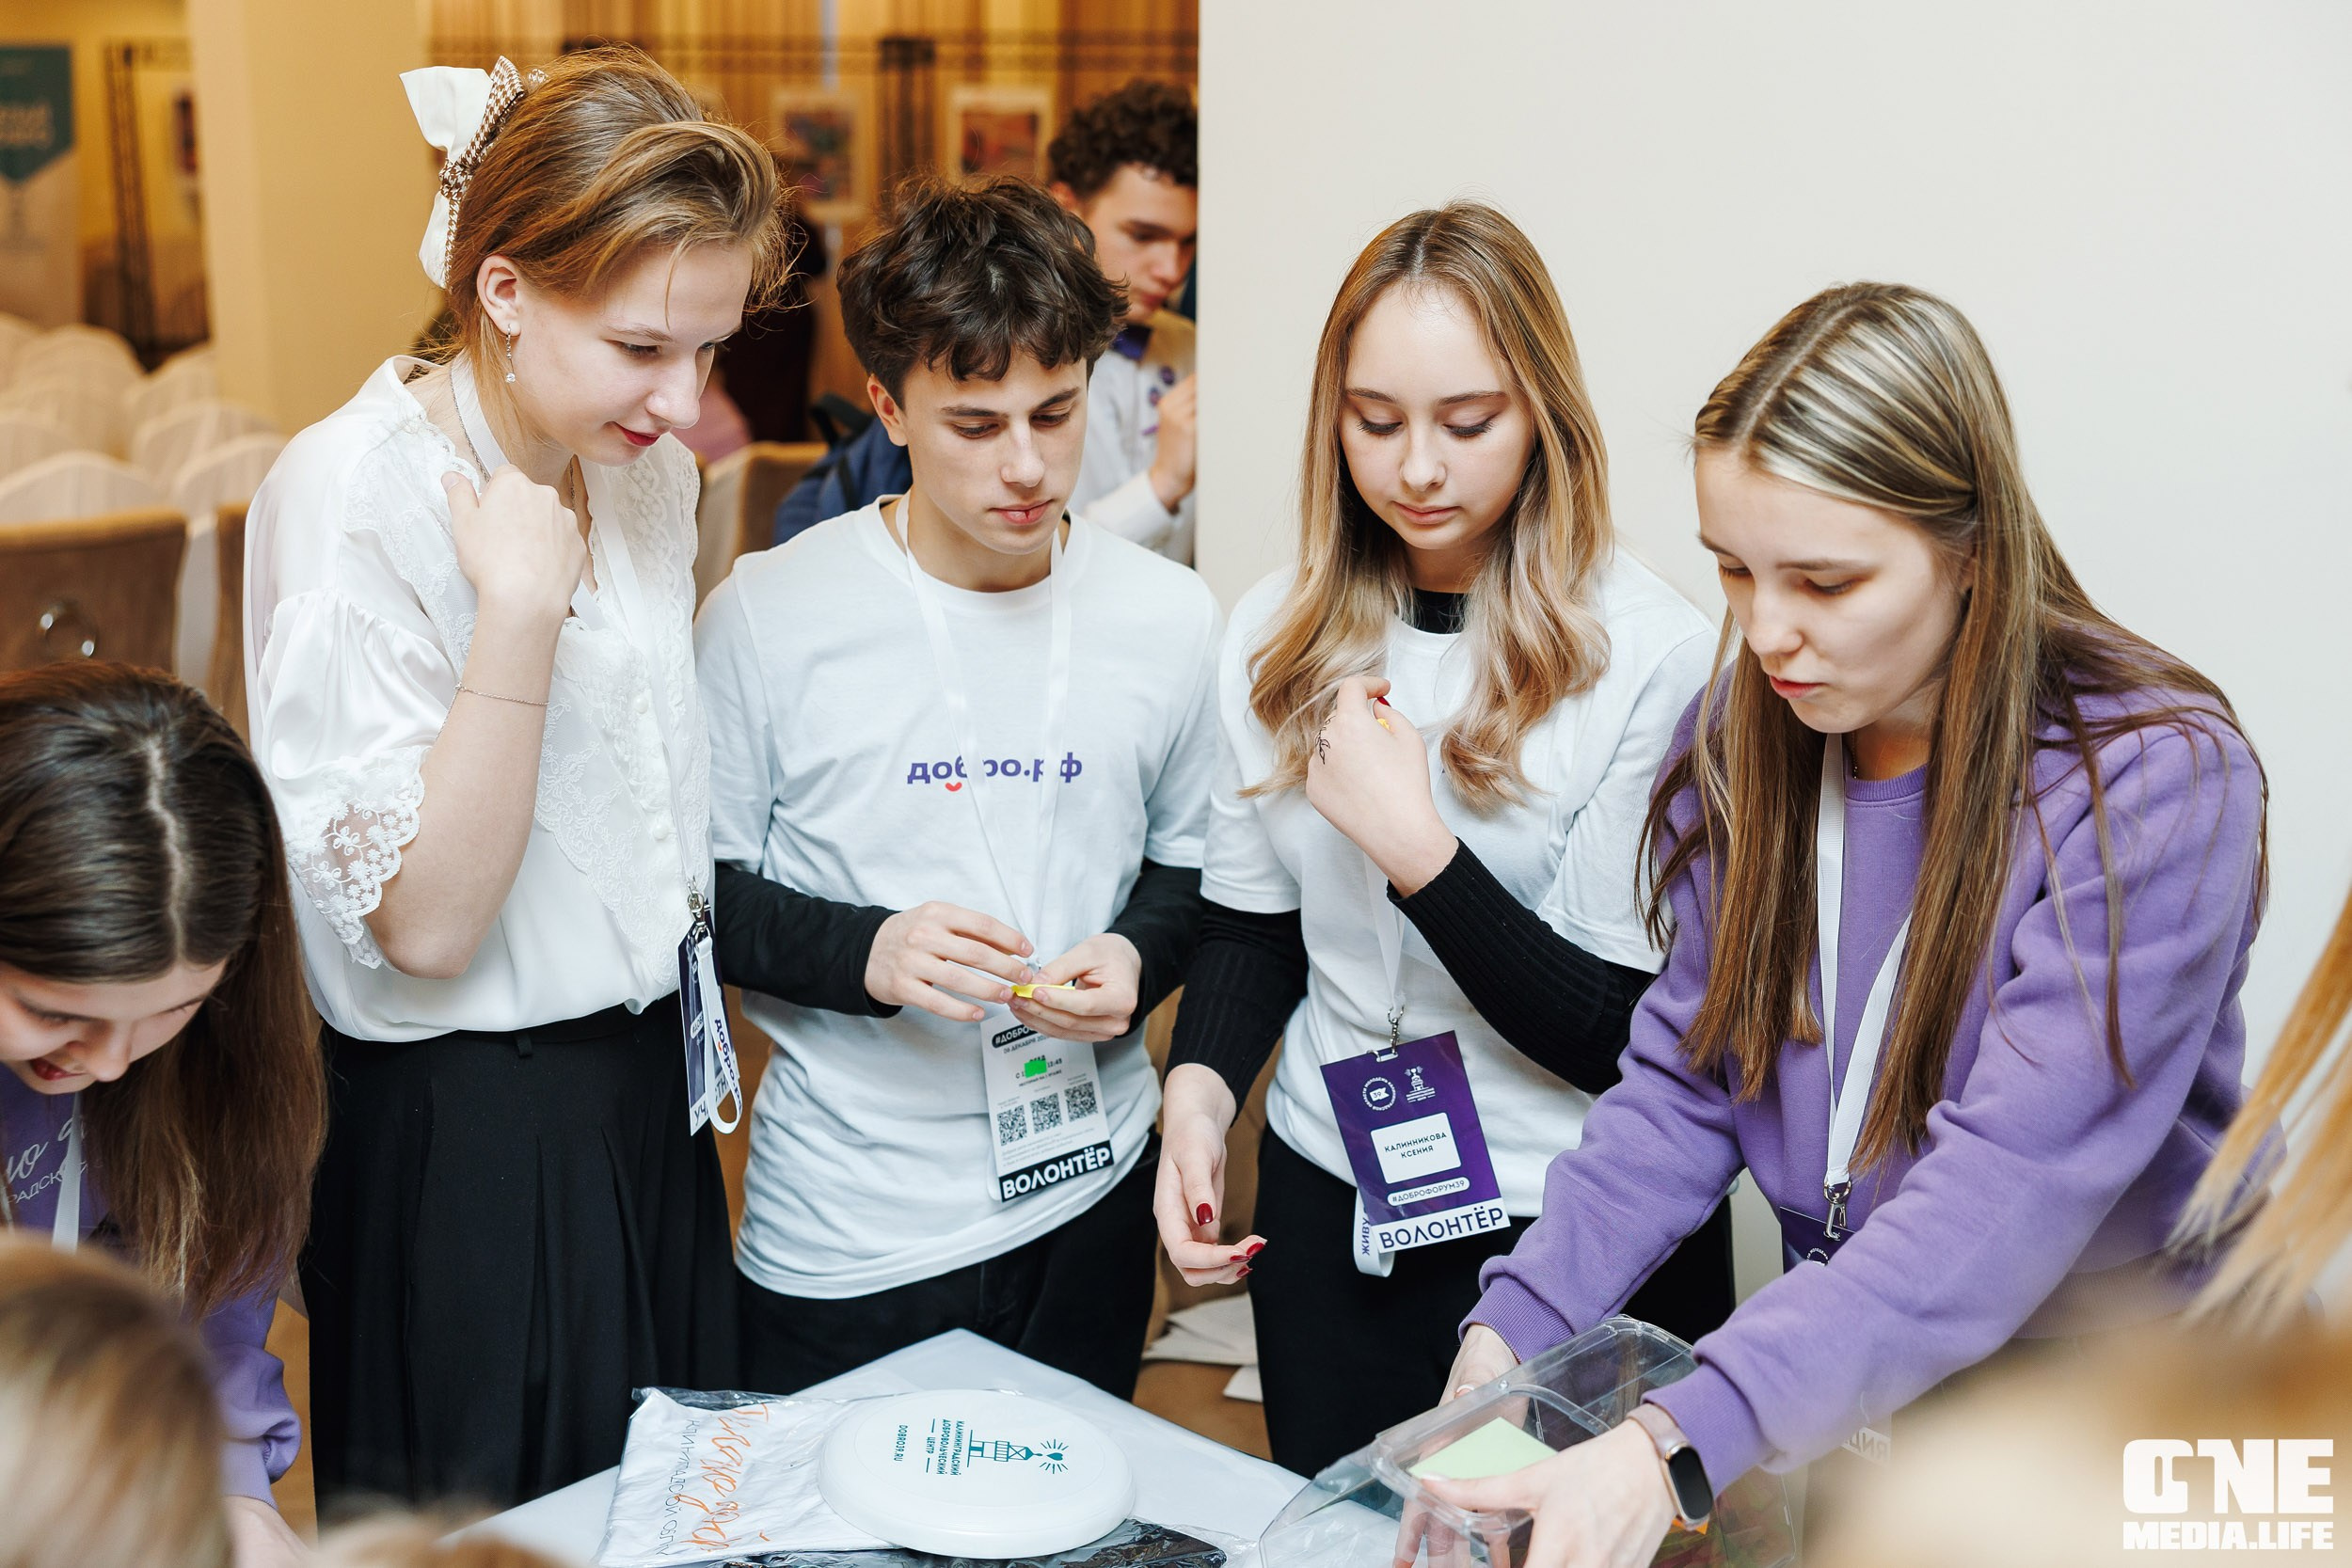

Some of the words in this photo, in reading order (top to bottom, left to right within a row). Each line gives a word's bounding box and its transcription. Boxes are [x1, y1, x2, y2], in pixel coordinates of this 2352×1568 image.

[995, 1026, 1032, 1044] #ДОБРО
[1384, 1132, 1447, 1152] КАЛИННИКОВА
[1400, 1145, 1434, 1159] КСЕНИЯ
[1001, 1146, 1111, 1200] ВОЛОНТЁР
[1392, 1180, 1465, 1202] #ДОБРОФОРУМ39
[1379, 1206, 1503, 1249] ВОЛОНТЁР
[894, 1424, 908, 1462] DOBRO39.RU
[926, 1436, 936, 1454] ЦЕНТР
[936, 1418, 951, 1475] ДОБРОВОЛЬЧЕСКИЙ
[950, 1420, 965, 1476] КАЛИНИНГРАДСКИЙ
